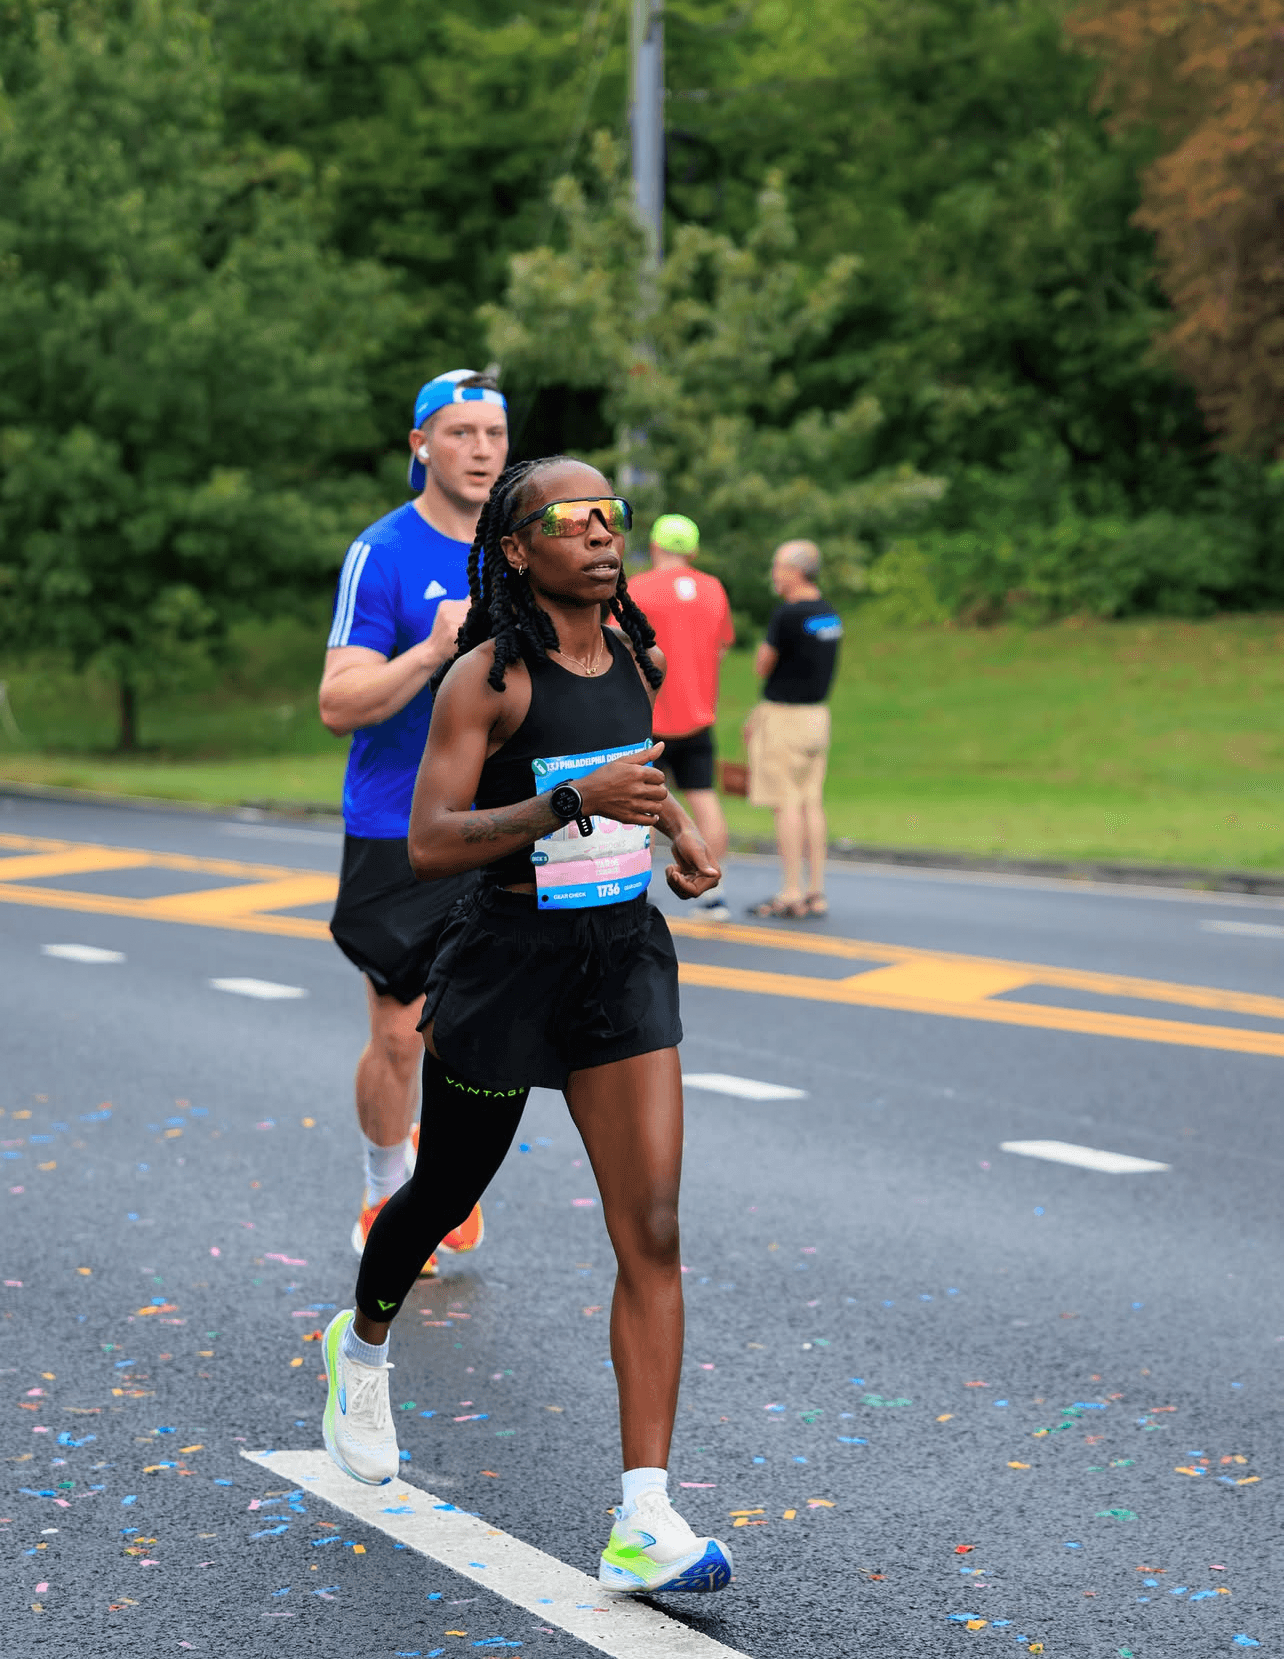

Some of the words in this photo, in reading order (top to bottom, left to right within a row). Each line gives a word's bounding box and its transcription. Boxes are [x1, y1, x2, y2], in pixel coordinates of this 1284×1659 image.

[560, 755, 606, 770] PHILADELPHIA
[569, 891, 587, 899] CHECK
[596, 882, 621, 898] 1736
[445, 1076, 525, 1098] VANTAGE
